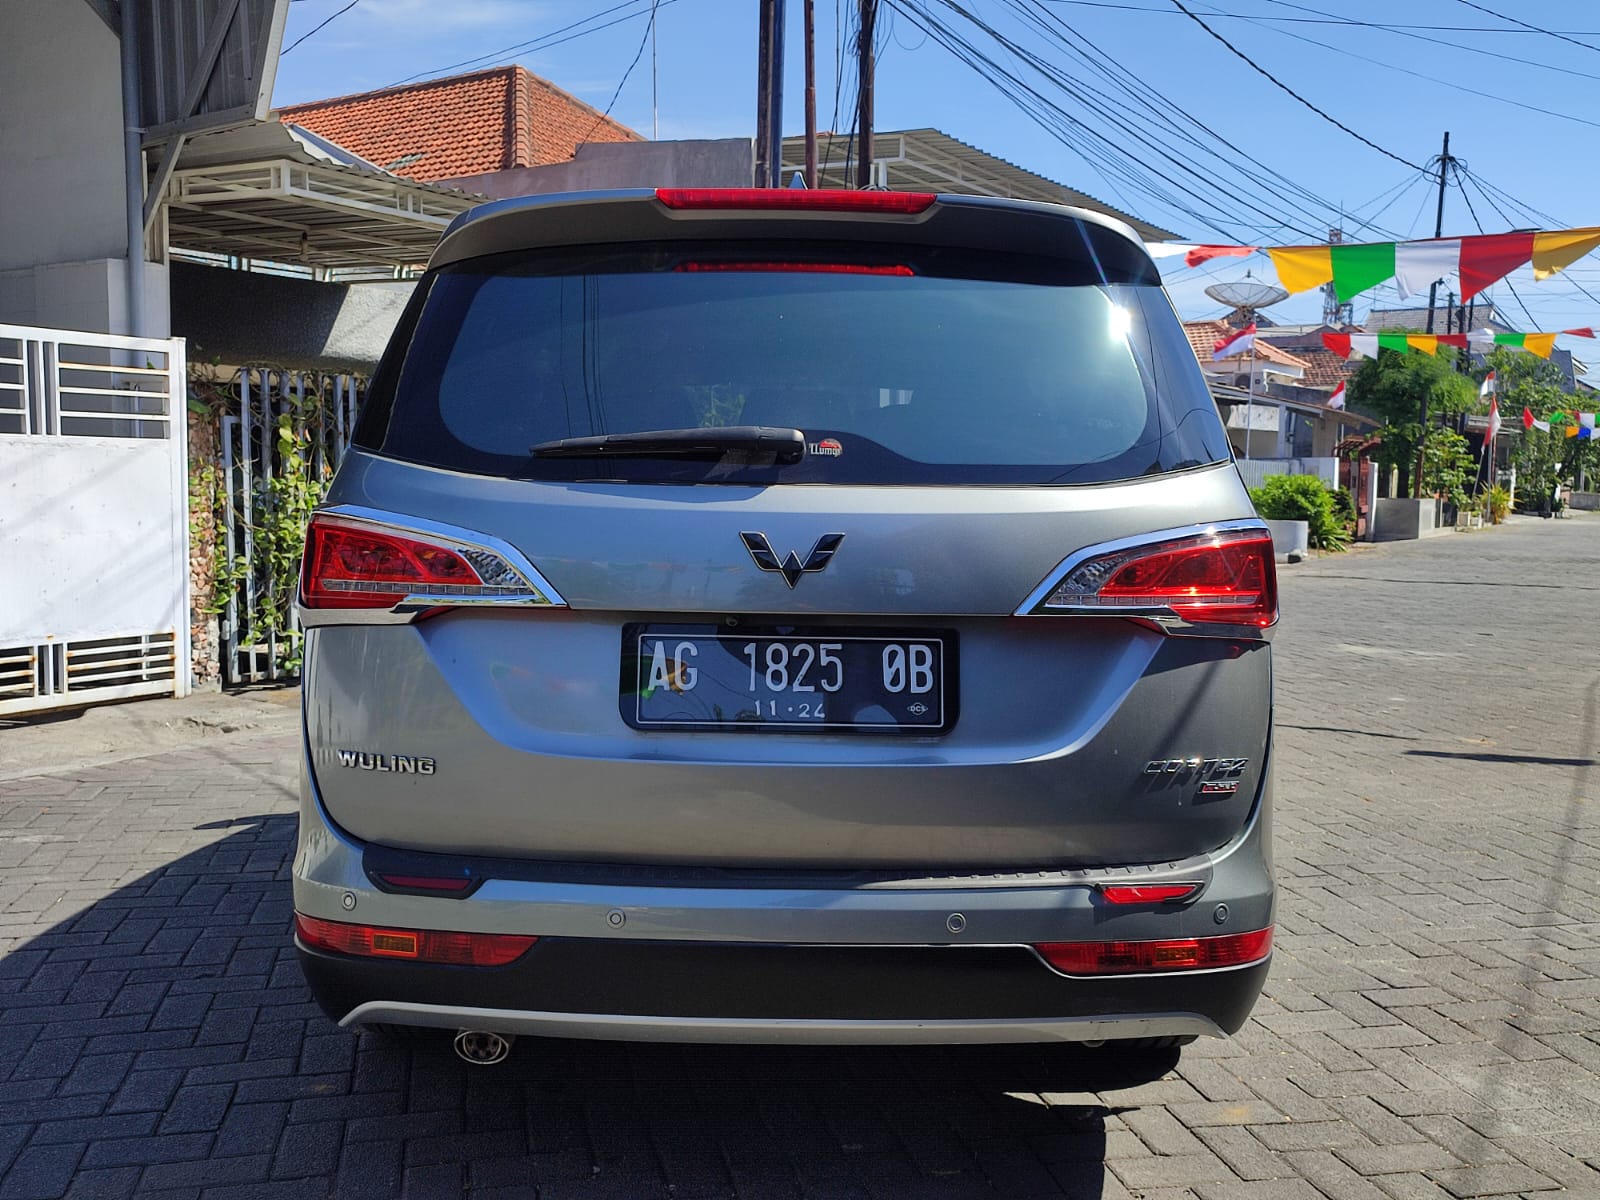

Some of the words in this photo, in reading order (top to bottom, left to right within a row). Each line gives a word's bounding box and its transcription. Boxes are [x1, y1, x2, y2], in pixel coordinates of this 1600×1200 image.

[647, 640, 699, 691] AG
[743, 642, 844, 692] 1825
[337, 749, 435, 774] WULING
